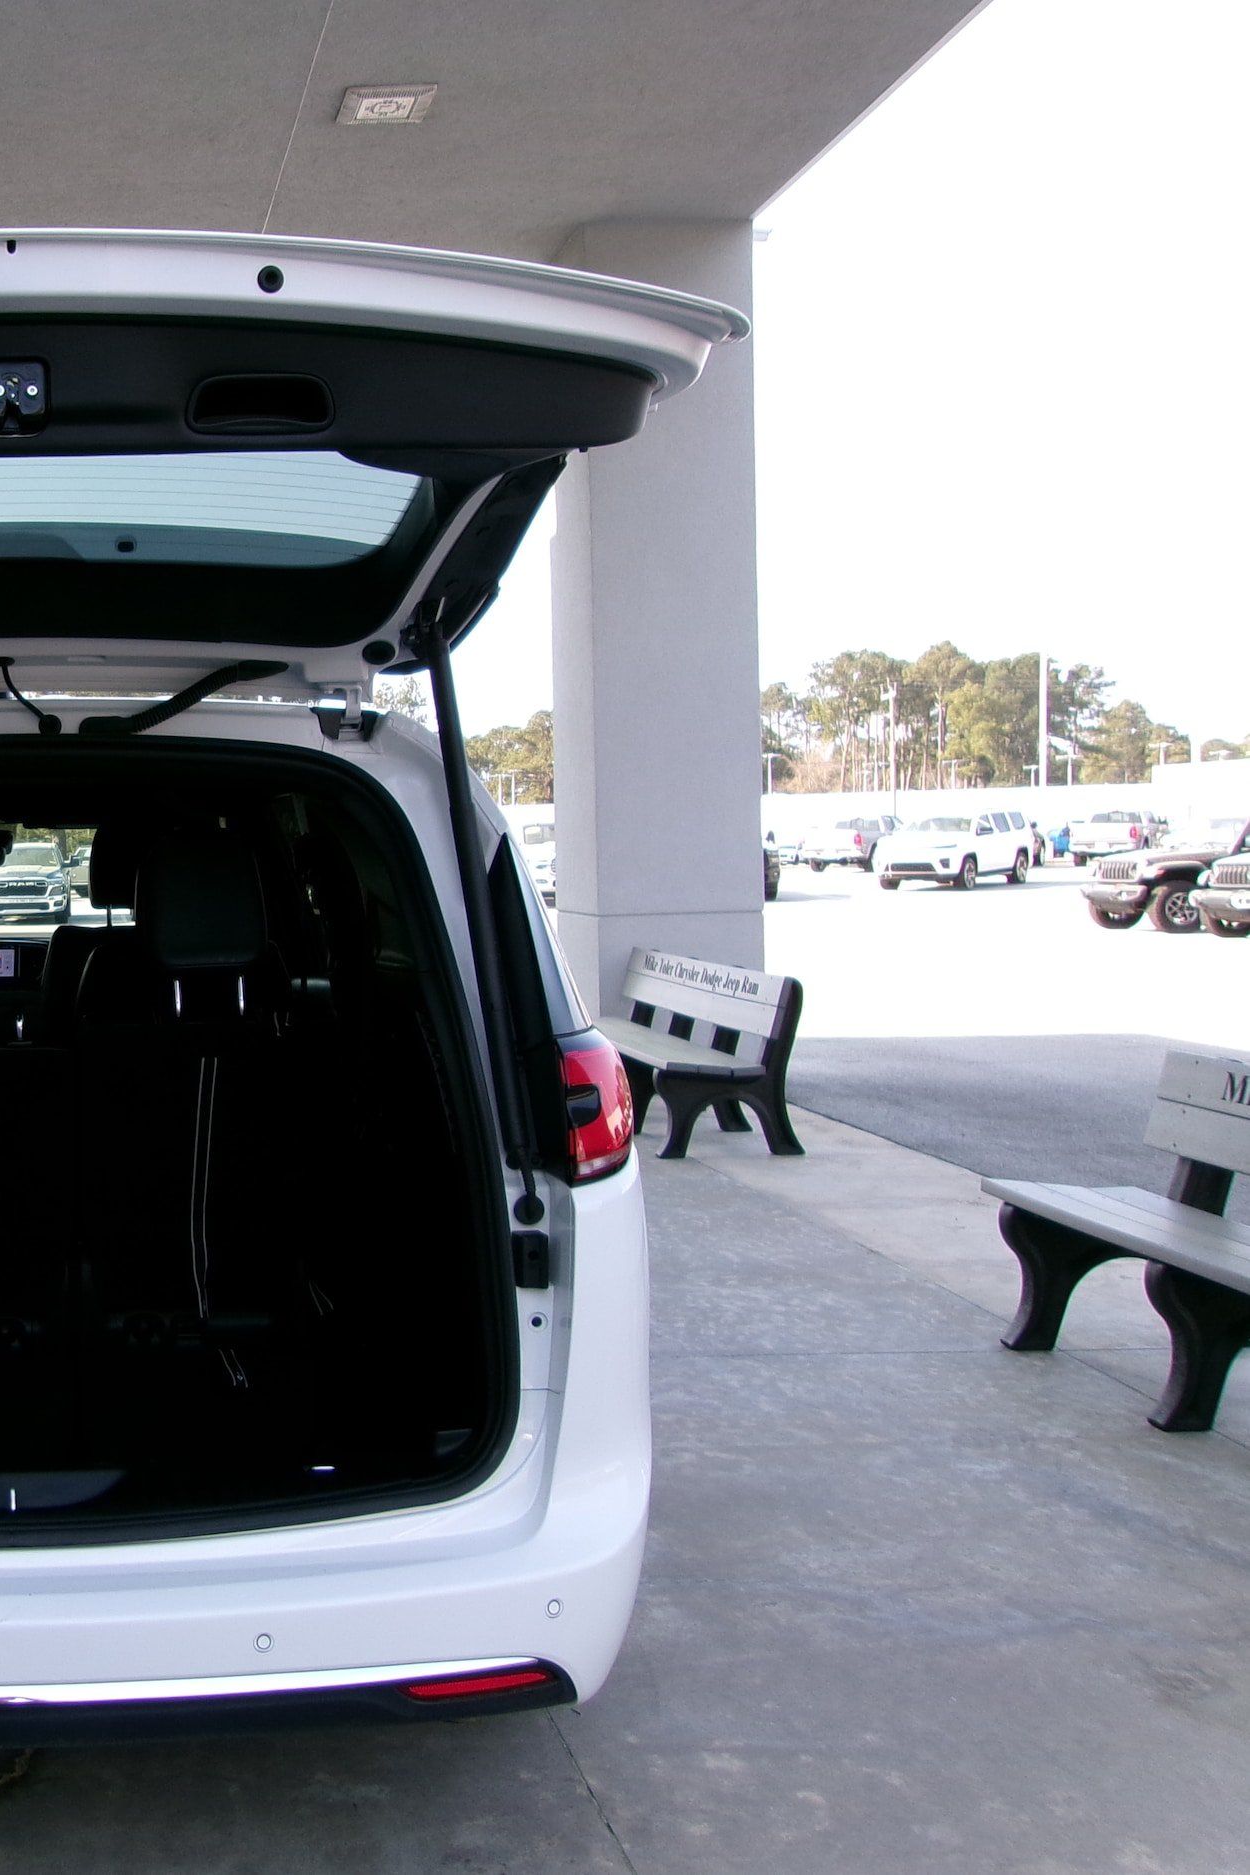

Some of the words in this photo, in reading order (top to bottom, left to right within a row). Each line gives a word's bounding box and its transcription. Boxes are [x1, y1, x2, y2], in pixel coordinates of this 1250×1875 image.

[644, 954, 659, 972] Mike
[659, 958, 674, 976] Toler
[674, 962, 700, 984] Chrysler
[700, 967, 723, 991] Dodge
[722, 971, 741, 997] Jeep
[741, 975, 759, 996] Ram
